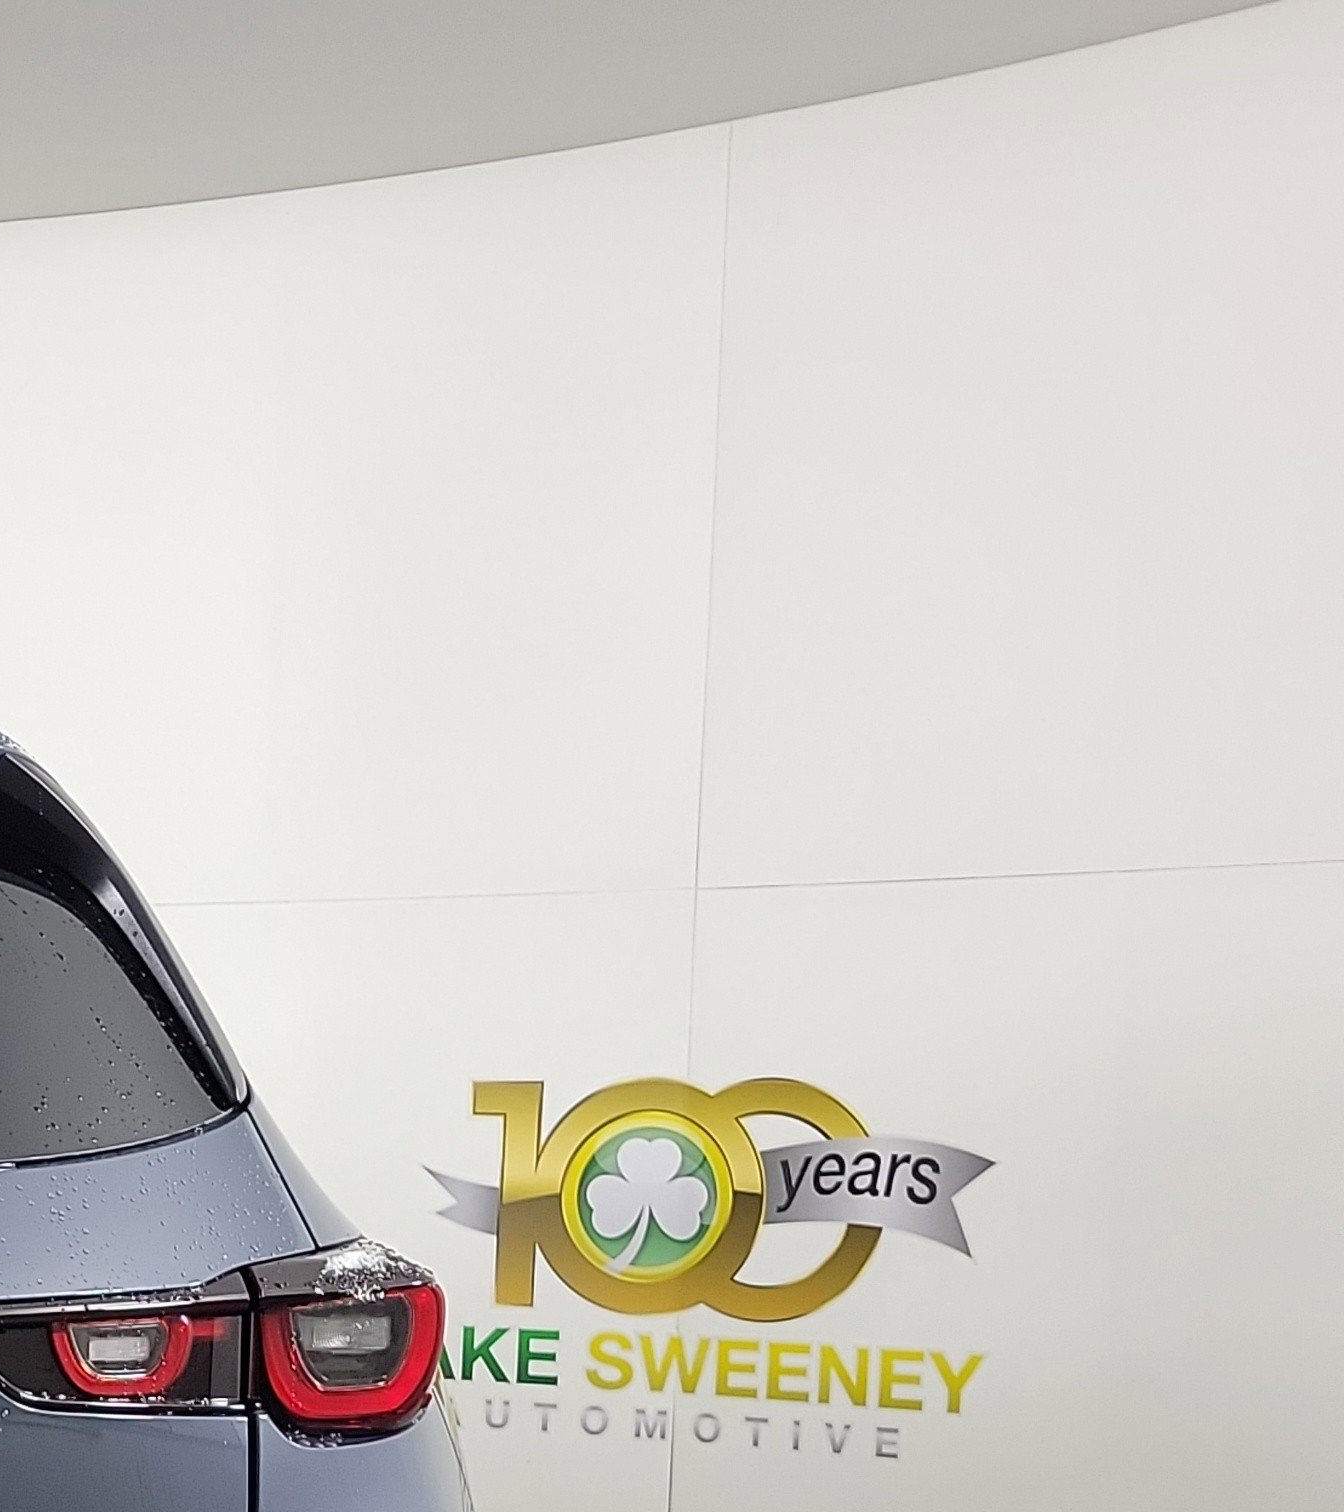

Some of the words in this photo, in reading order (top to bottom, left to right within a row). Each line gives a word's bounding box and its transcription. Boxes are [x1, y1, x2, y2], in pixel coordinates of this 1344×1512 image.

[775, 1150, 942, 1214] years
[585, 1333, 984, 1415] SWEENEY
[450, 1397, 900, 1460] UTOMOTIVE
